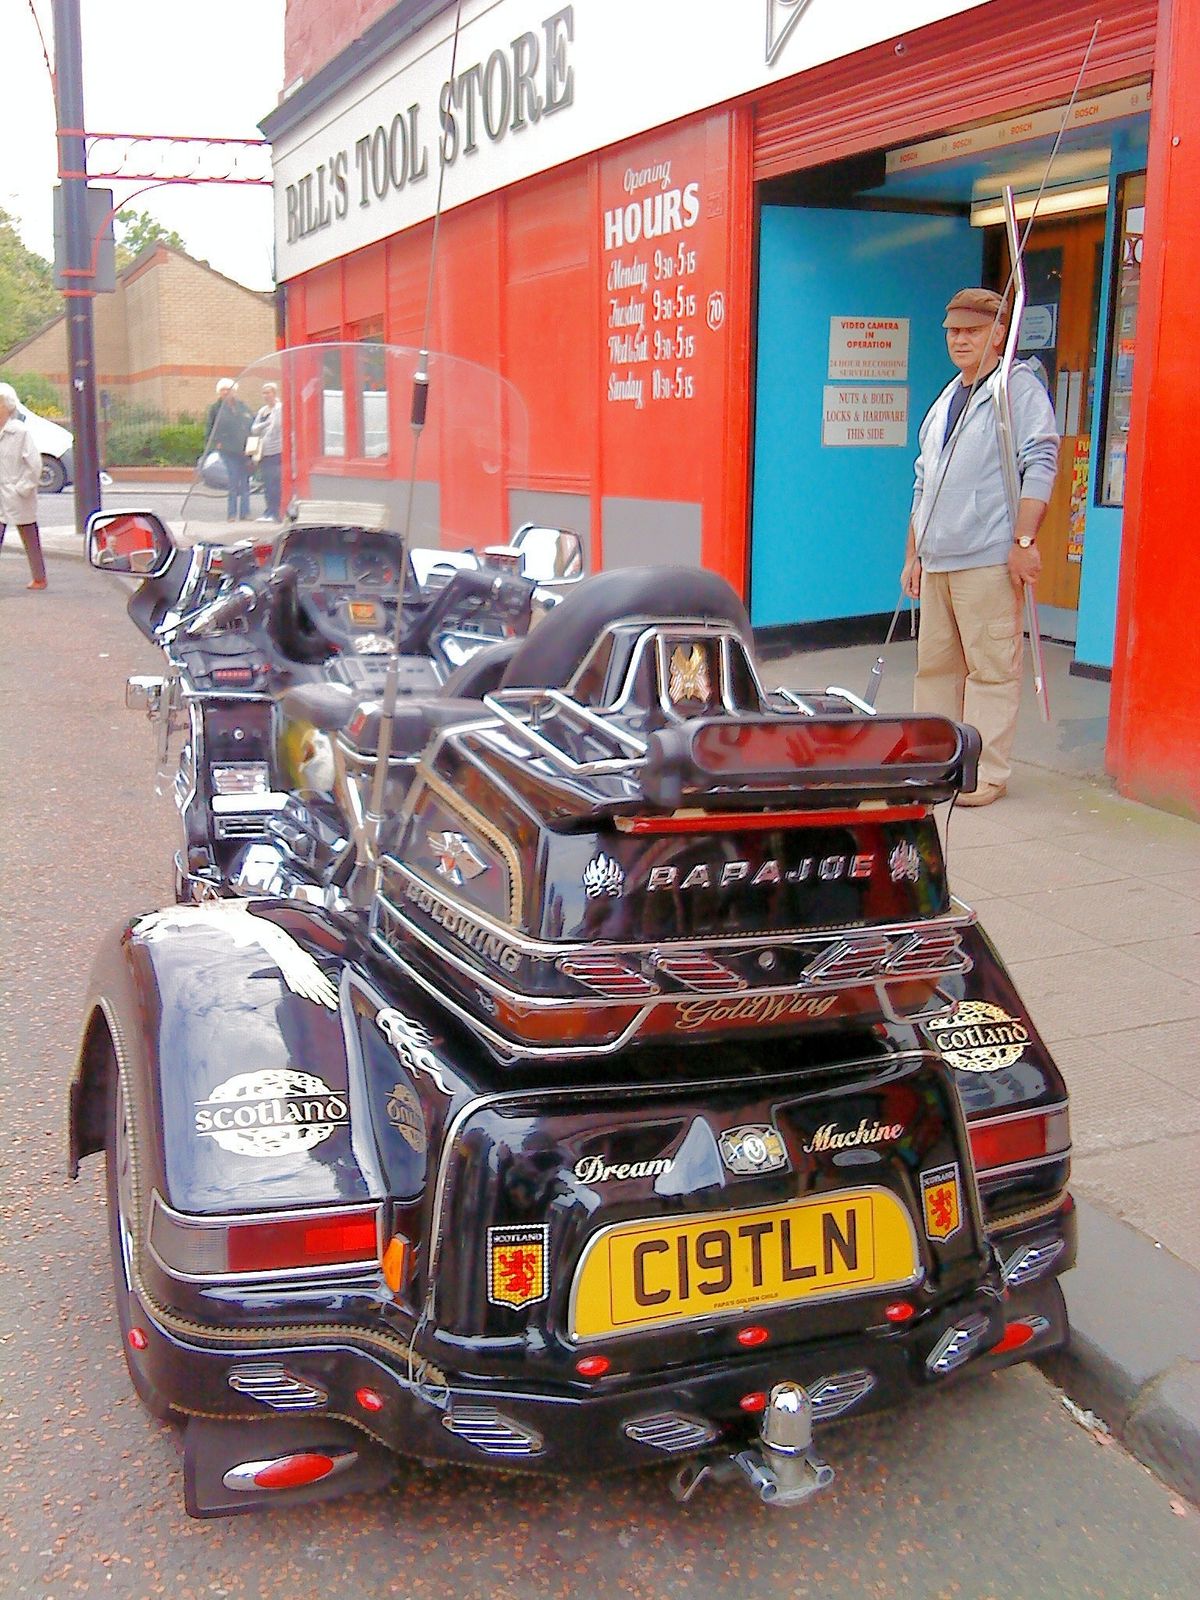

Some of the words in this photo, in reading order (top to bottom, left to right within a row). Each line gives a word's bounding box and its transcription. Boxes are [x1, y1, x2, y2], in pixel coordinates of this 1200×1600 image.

[285, 150, 348, 244] BILL'S
[355, 103, 428, 208] TOOL
[439, 4, 575, 168] STORE
[952, 137, 972, 150] BOSCH
[1010, 121, 1033, 135] BOSCH
[1075, 104, 1099, 119] BOSCH
[623, 160, 671, 195] Opening
[604, 182, 700, 250] HOURS
[607, 255, 648, 294] Monday
[840, 322, 865, 330] VIDEO
[867, 322, 899, 330] CAMERA
[865, 331, 875, 339] IN
[846, 341, 892, 349] OPERATION
[608, 371, 643, 410] Sunday
[839, 393, 859, 404] NUTS
[862, 393, 868, 404] &
[871, 393, 894, 404] BOLTS
[826, 411, 851, 422] LOCKS
[854, 411, 859, 422] &
[863, 411, 905, 422] HARDWARE
[847, 429, 864, 440] THIS
[867, 429, 885, 440] SIDE
[405, 880, 523, 973] GOLDWING
[675, 993, 840, 1030] GoldWing
[574, 1154, 676, 1186] Dream
[802, 1118, 905, 1154] Machine
[493, 1233, 543, 1243] SCOTLAND
[735, 1295, 760, 1305] GOLDEN
